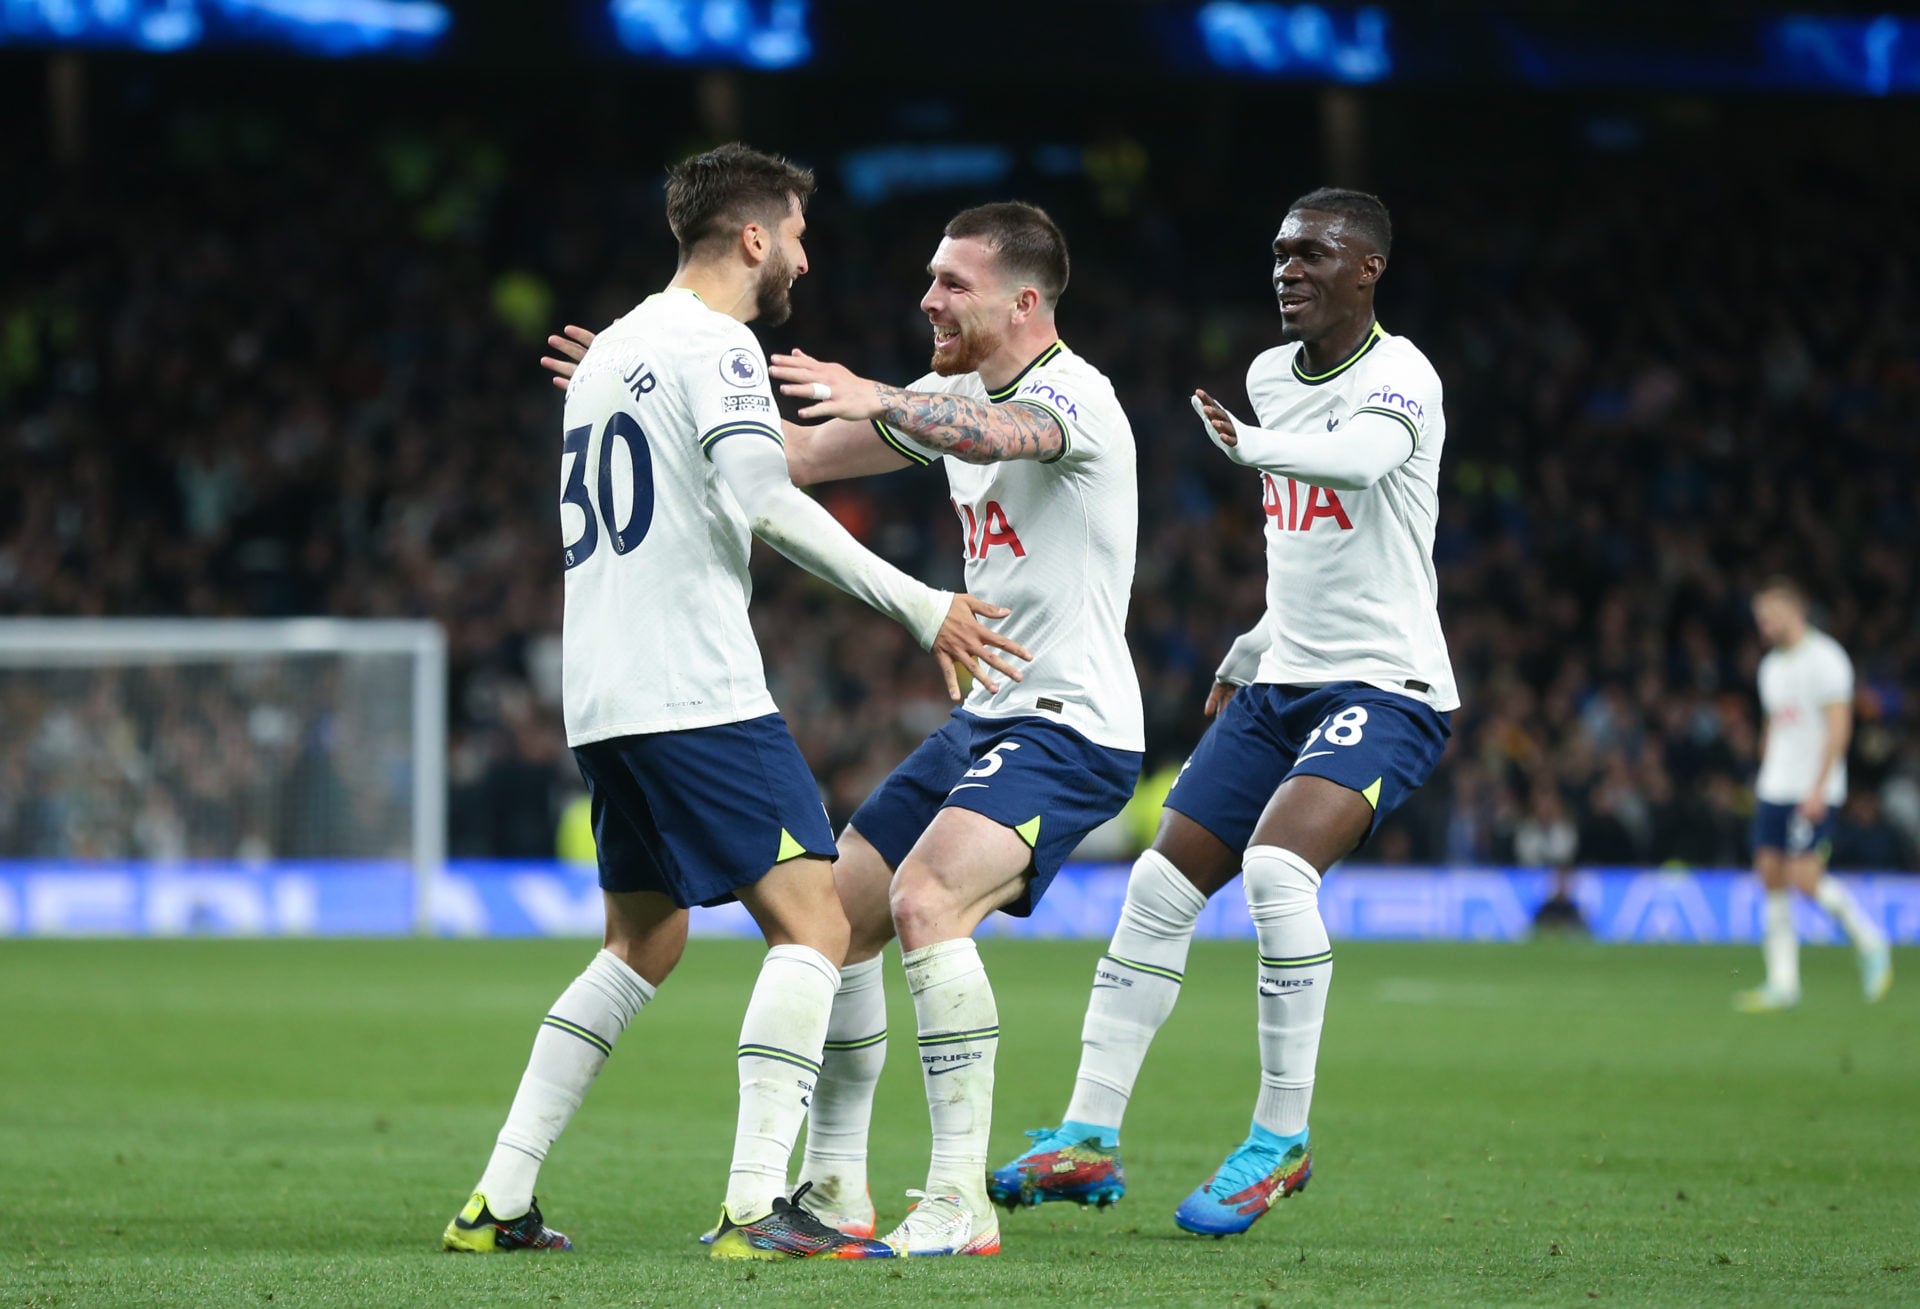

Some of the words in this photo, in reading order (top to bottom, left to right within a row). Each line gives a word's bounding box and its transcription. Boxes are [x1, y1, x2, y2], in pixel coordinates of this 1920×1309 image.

[560, 411, 655, 571] 30
[1263, 472, 1354, 531] AIA
[950, 496, 1026, 559] IA
[963, 741, 1021, 778] 5
[1097, 970, 1134, 988] URS
[1260, 975, 1315, 988] SPURS
[921, 1050, 983, 1064] SPURS
